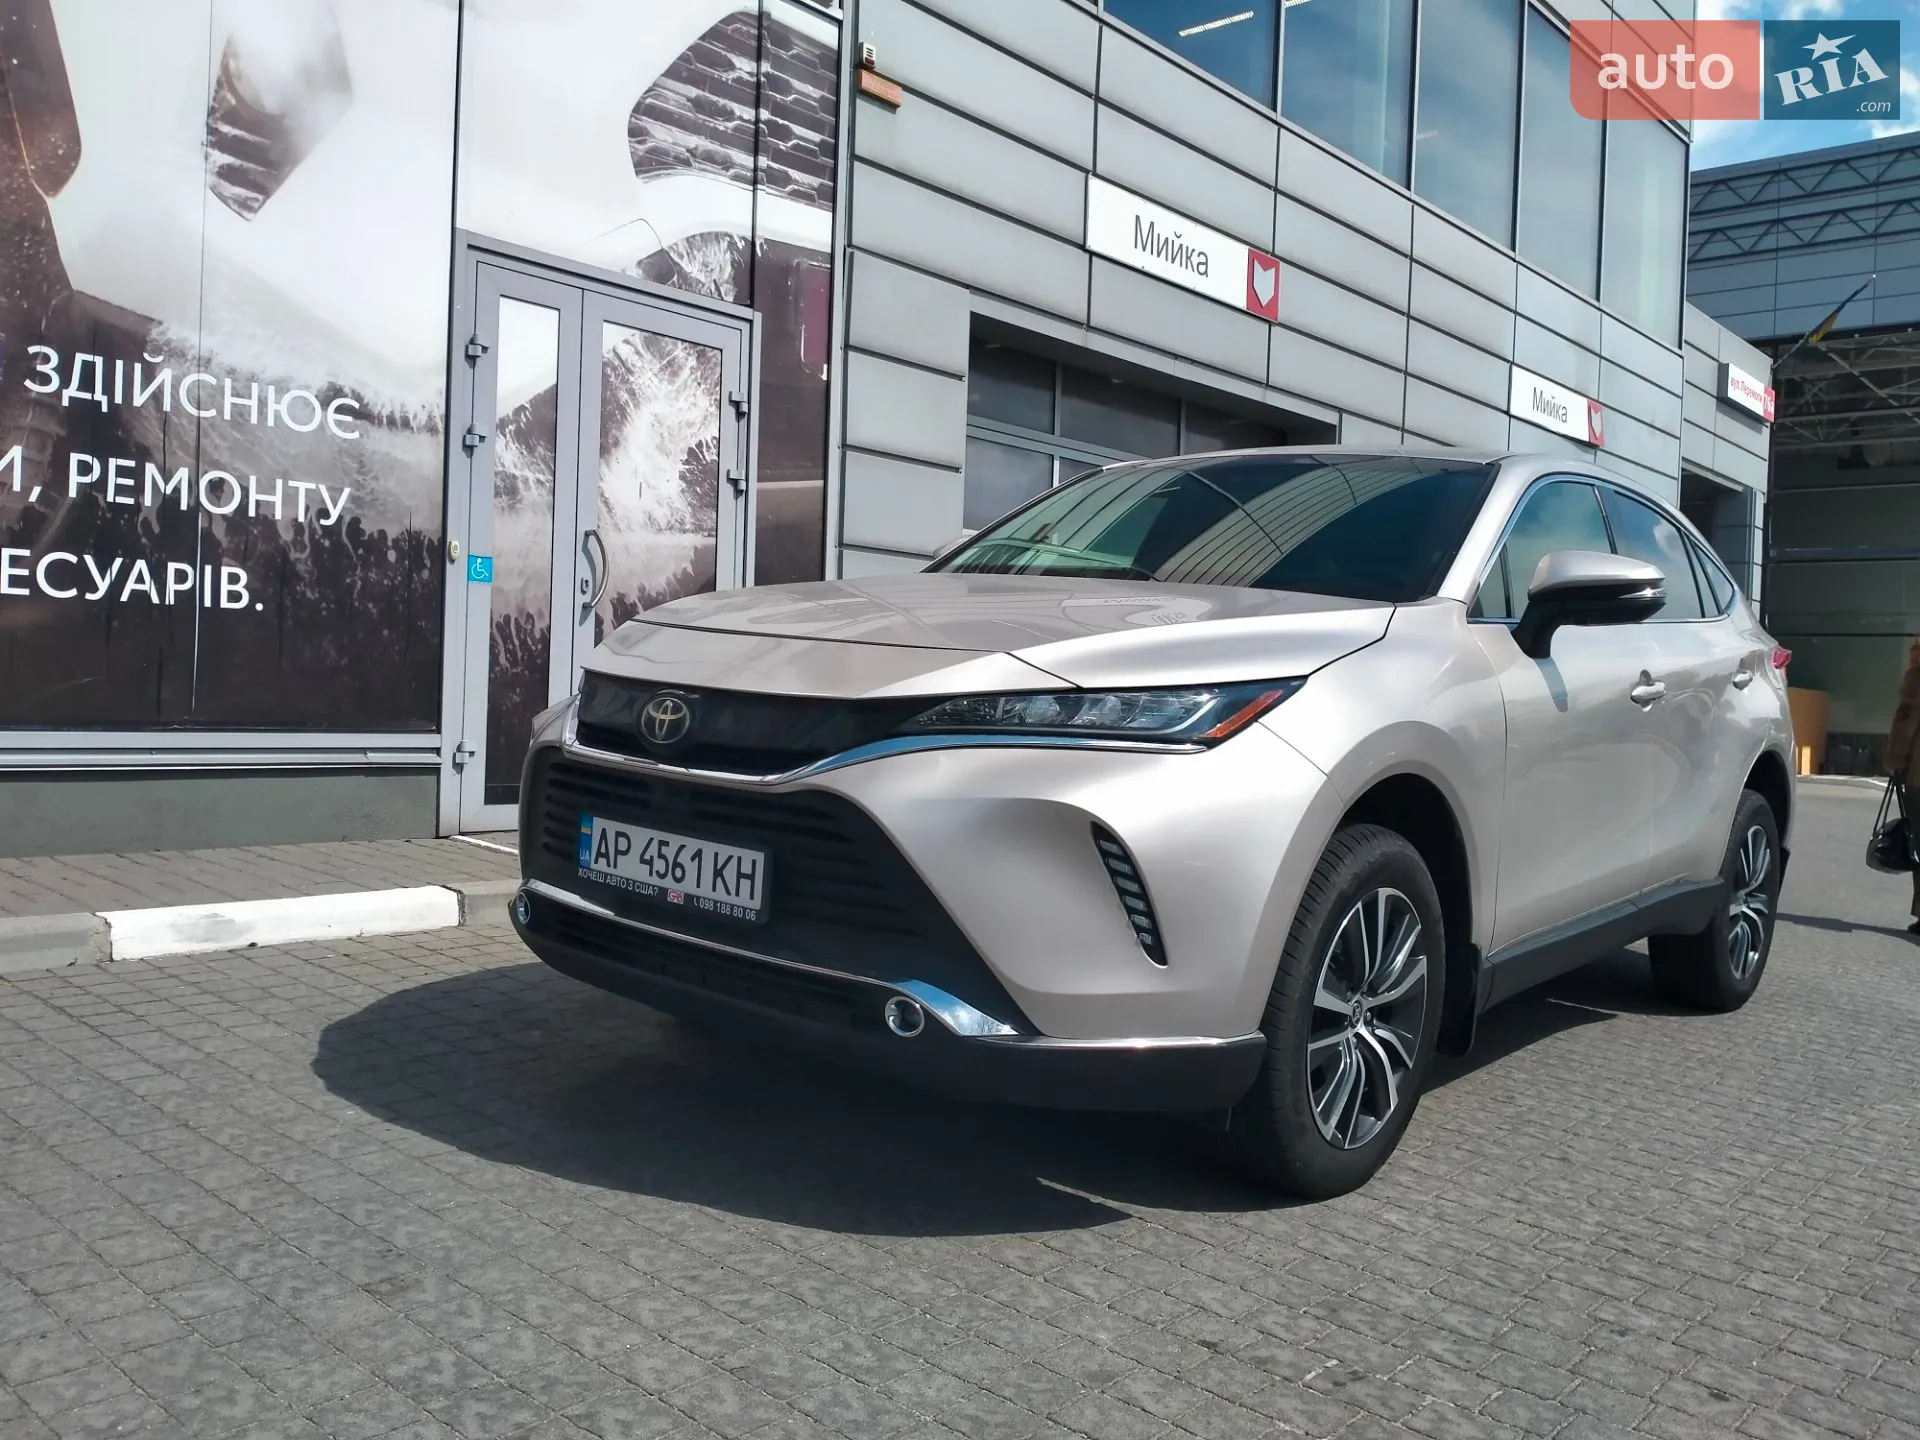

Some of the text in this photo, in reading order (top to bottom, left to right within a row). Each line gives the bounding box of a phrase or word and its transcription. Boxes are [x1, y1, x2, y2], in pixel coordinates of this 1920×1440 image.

[1134, 214, 1209, 278] Мийка
[23, 345, 361, 440] ЗДІЙСНЮЄ
[1532, 386, 1568, 424] Мийка
[68, 452, 351, 526] РЕМОНТУ
[0, 547, 264, 612] ЕСУАРІВ.
[578, 867, 605, 883] ХОЧЕШ
[606, 874, 627, 889] АВТО
[634, 882, 659, 897] США?
[580, 848, 590, 861] UA
[593, 827, 757, 900] AP 4561 KH
[700, 898, 757, 921] 098 188 80 06
